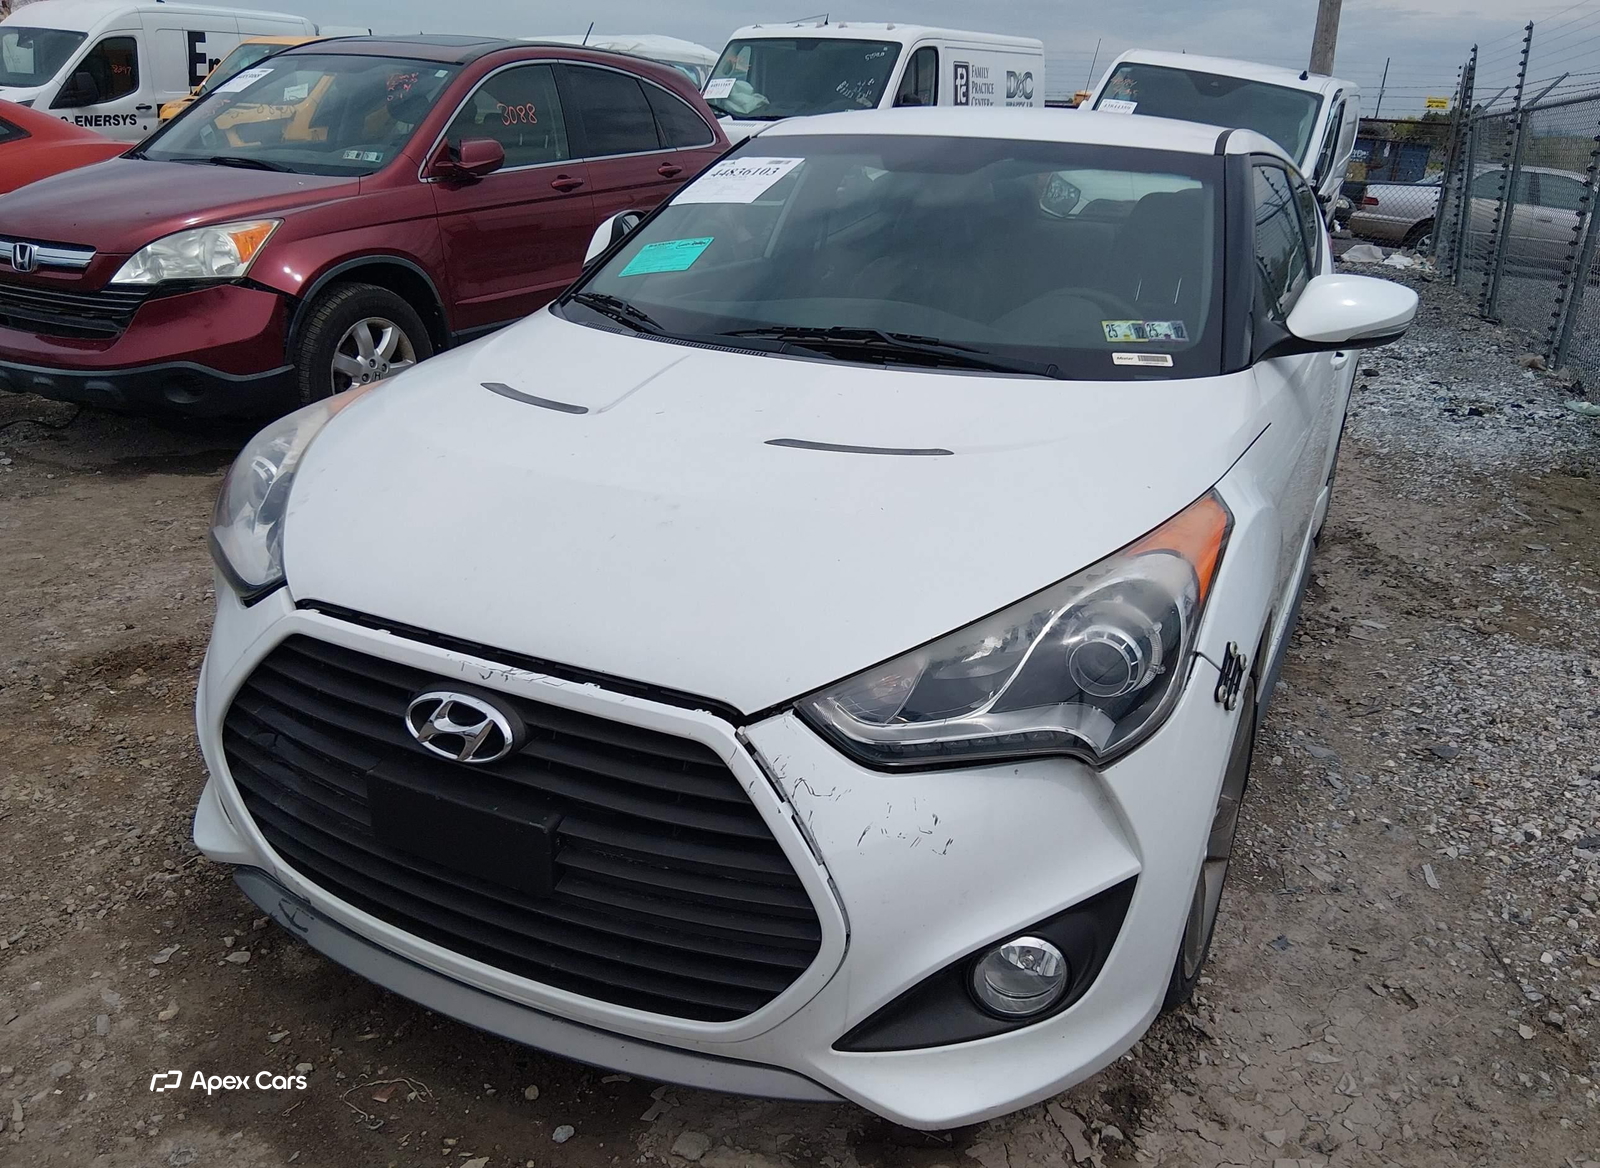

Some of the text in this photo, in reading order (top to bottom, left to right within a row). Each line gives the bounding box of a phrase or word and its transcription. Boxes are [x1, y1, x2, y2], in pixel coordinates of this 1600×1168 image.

[971, 65, 990, 79] FAMILY
[971, 81, 995, 95] PRACTICE
[496, 103, 538, 126] 3088
[710, 166, 781, 178] 44836103
[1105, 323, 1119, 339] 25
[1146, 323, 1160, 338] 25
